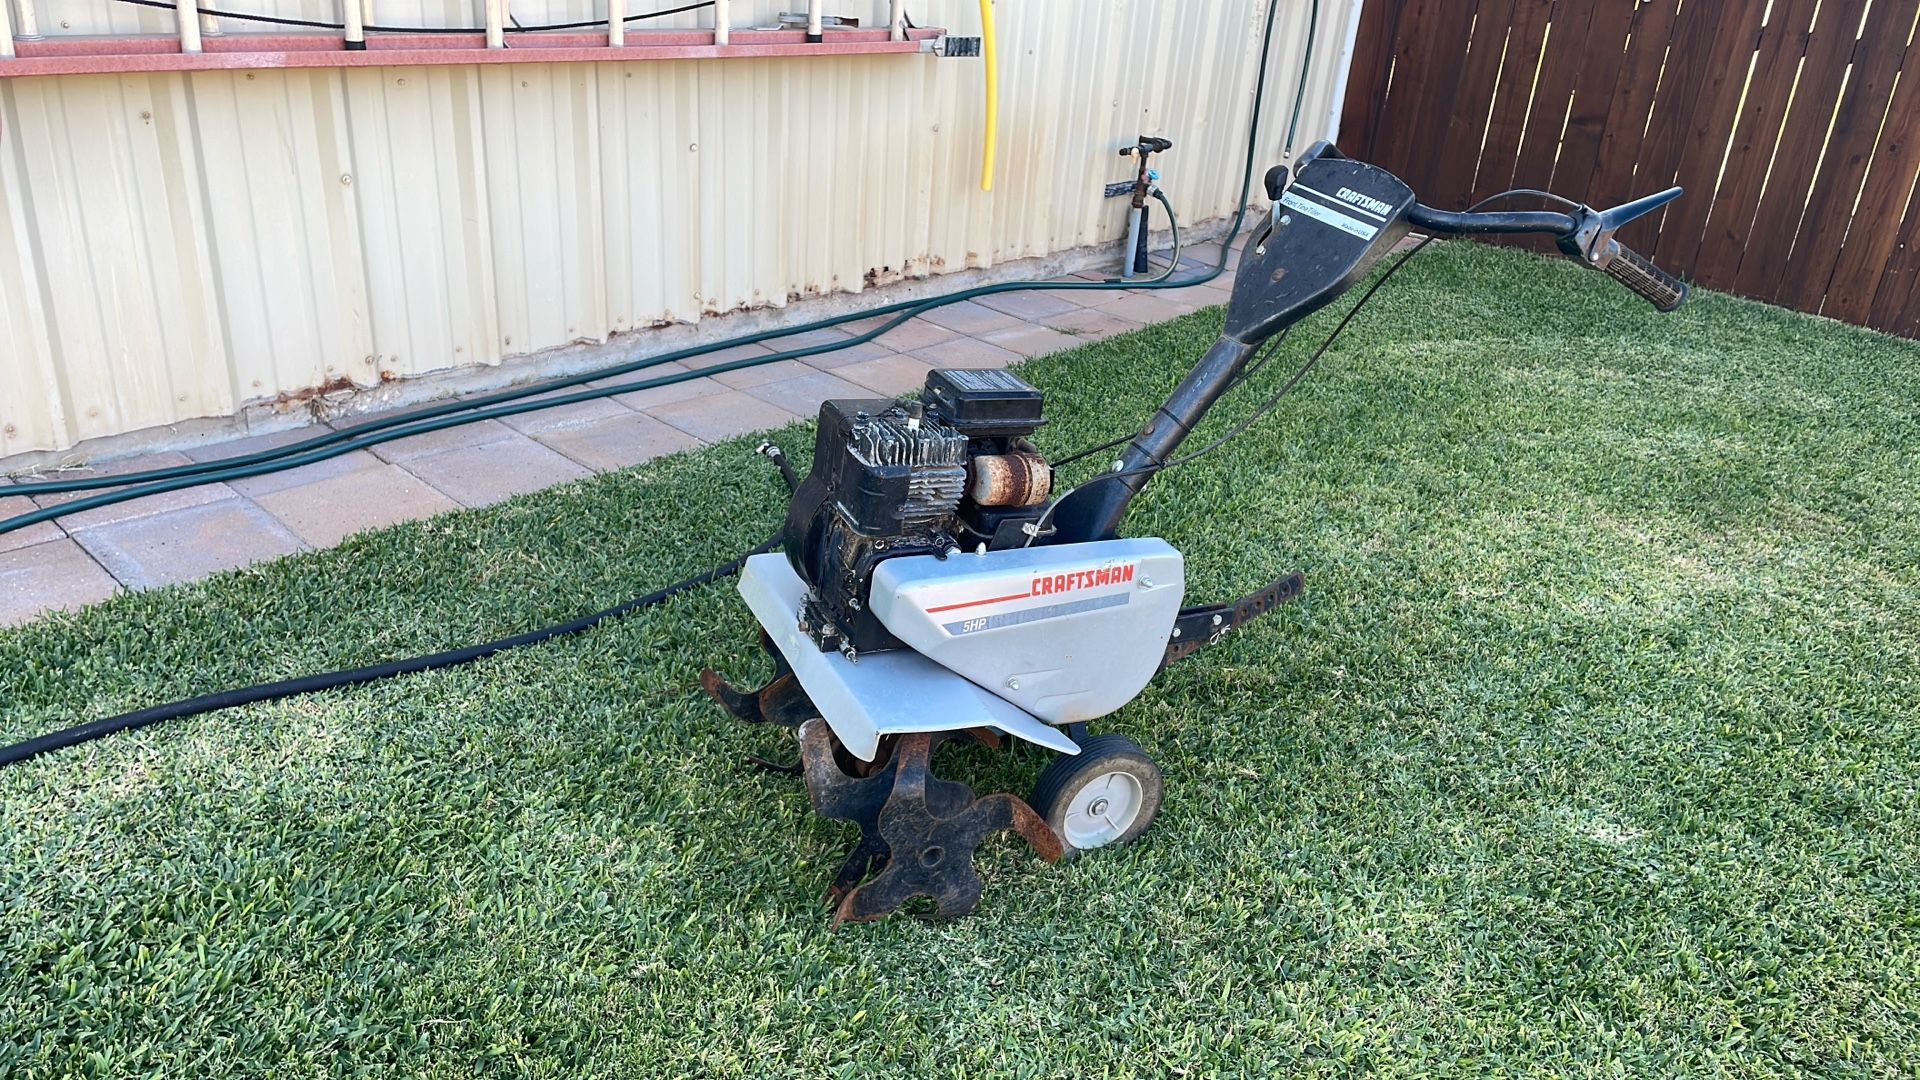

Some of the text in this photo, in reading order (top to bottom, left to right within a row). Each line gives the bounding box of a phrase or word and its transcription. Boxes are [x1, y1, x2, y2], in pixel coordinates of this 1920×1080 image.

[1336, 187, 1393, 216] CRAFTSMAN
[1031, 564, 1134, 597] CRAFTSMAN
[963, 617, 987, 633] 5HP
